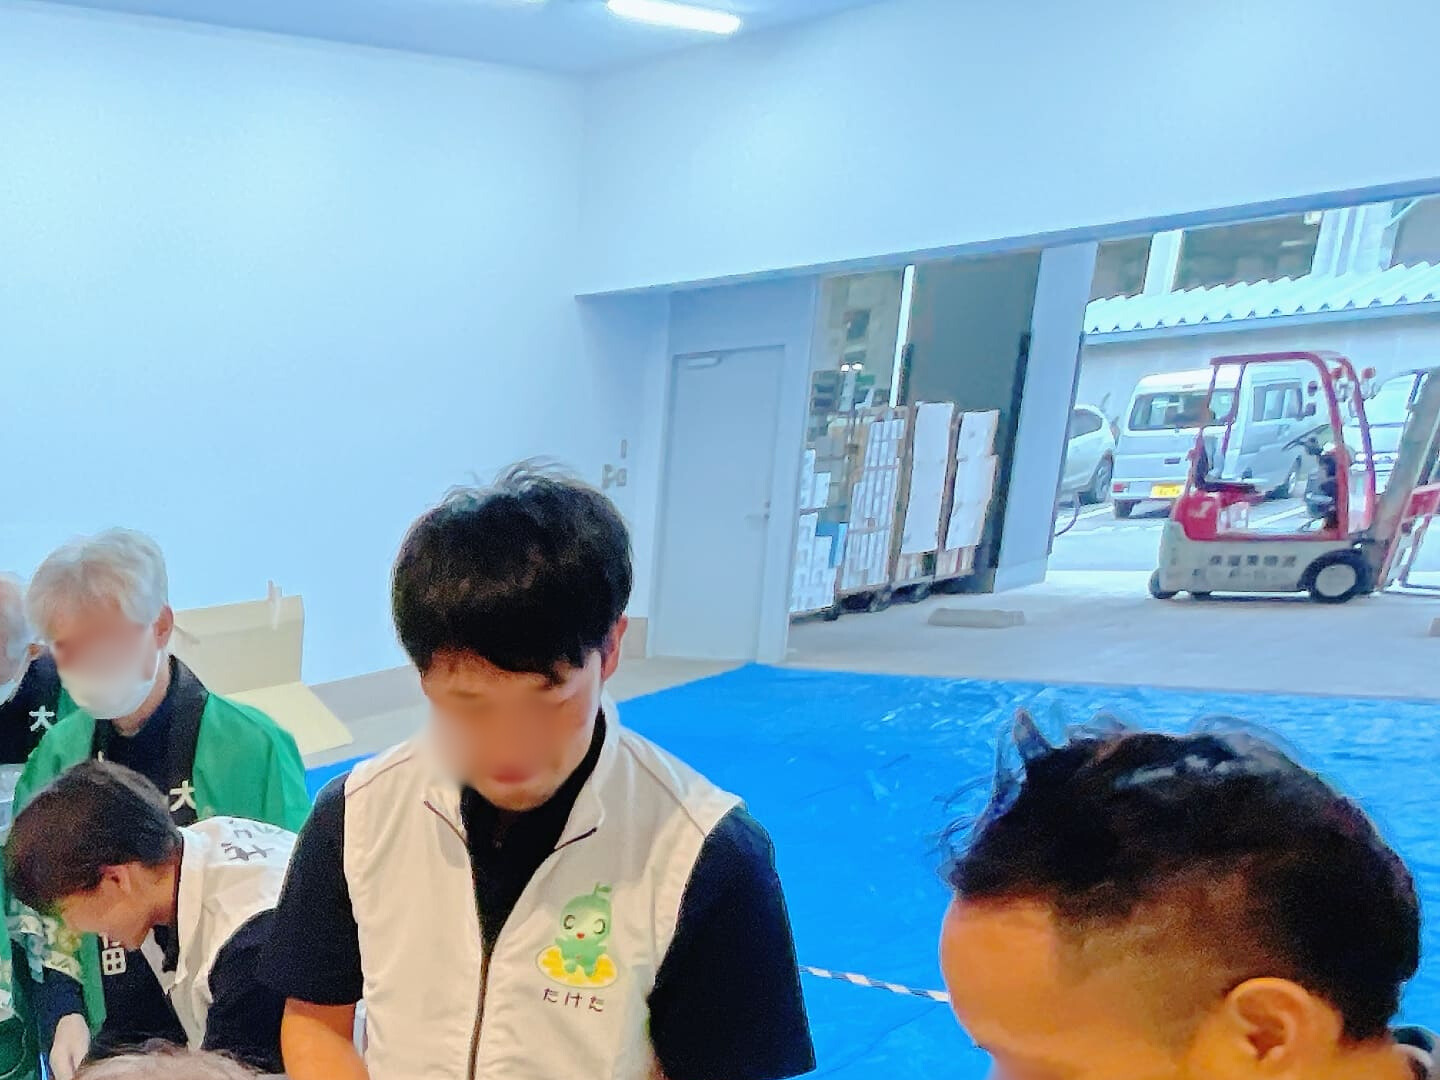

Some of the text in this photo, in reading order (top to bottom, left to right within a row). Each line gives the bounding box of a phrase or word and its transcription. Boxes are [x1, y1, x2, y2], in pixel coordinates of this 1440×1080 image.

[28, 704, 57, 732] 大
[169, 779, 198, 813] 大
[543, 987, 605, 1013] たけた
